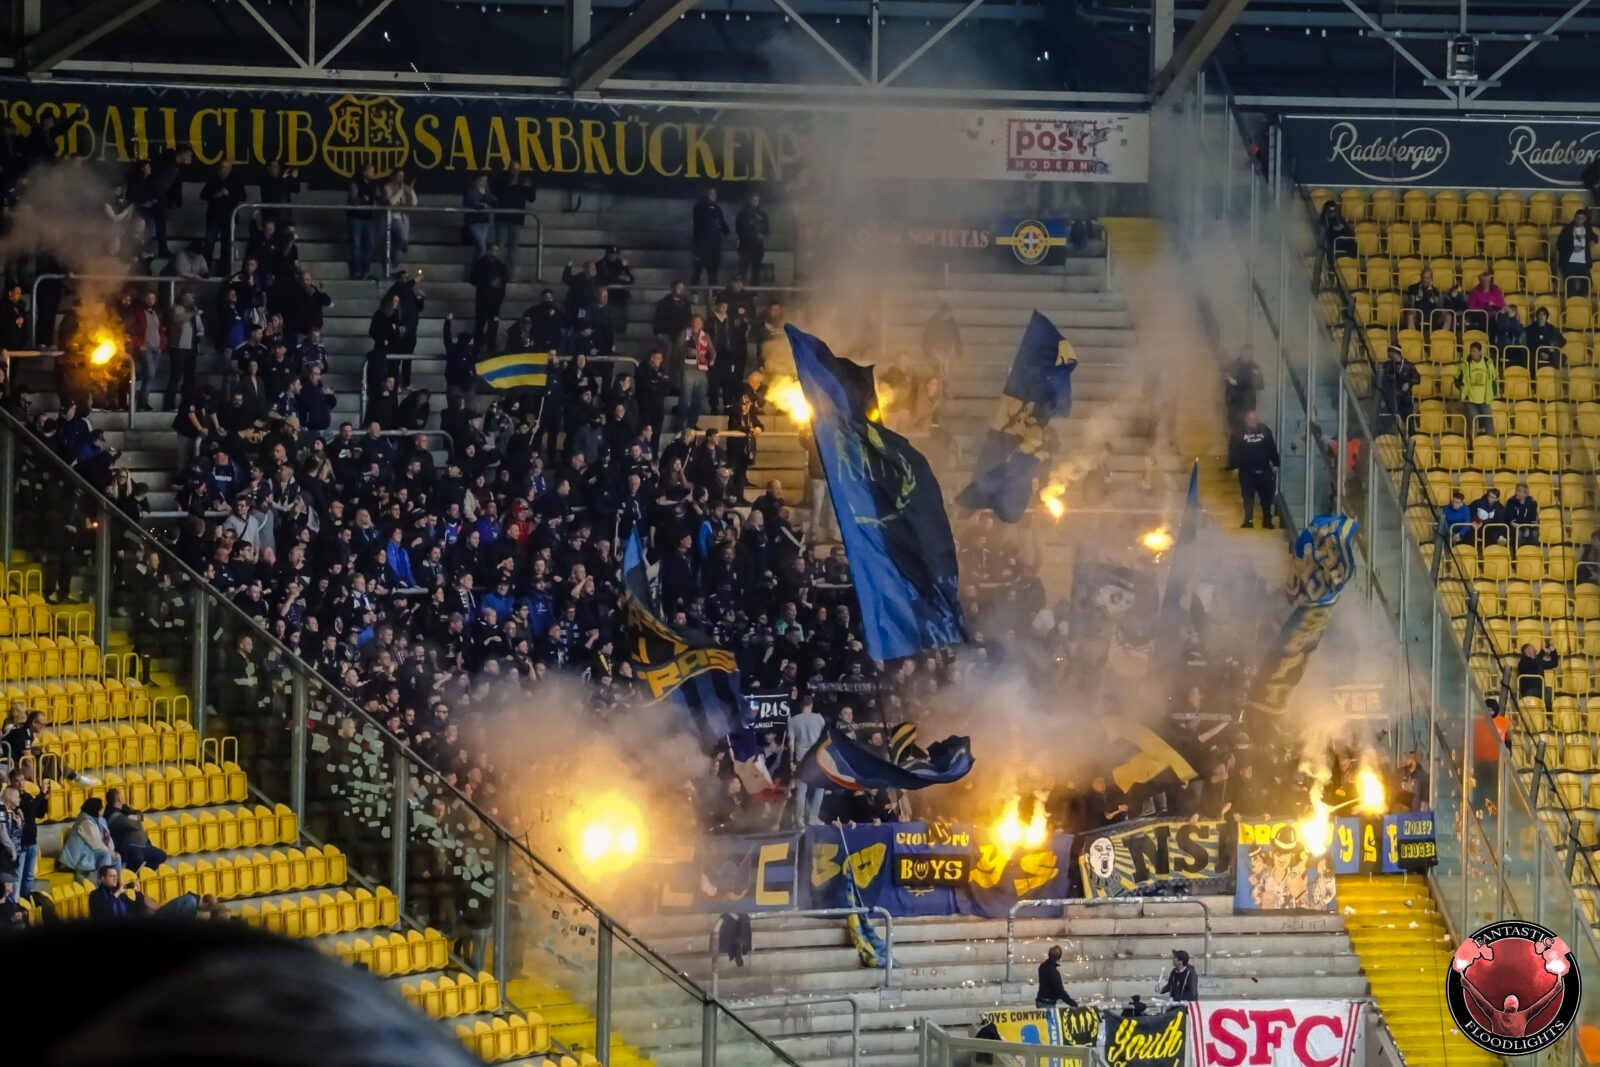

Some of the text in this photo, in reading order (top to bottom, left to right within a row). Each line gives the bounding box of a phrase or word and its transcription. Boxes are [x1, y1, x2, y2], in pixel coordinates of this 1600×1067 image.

[413, 114, 784, 182] SAARBRÜCKEN
[1015, 160, 1088, 171] MODERN
[1327, 122, 1446, 172] Radeberger
[908, 228, 990, 249] SOCIETAS
[901, 859, 963, 880] BOYS
[1107, 1010, 1183, 1061] Youth
[1206, 1008, 1343, 1067] SFC
